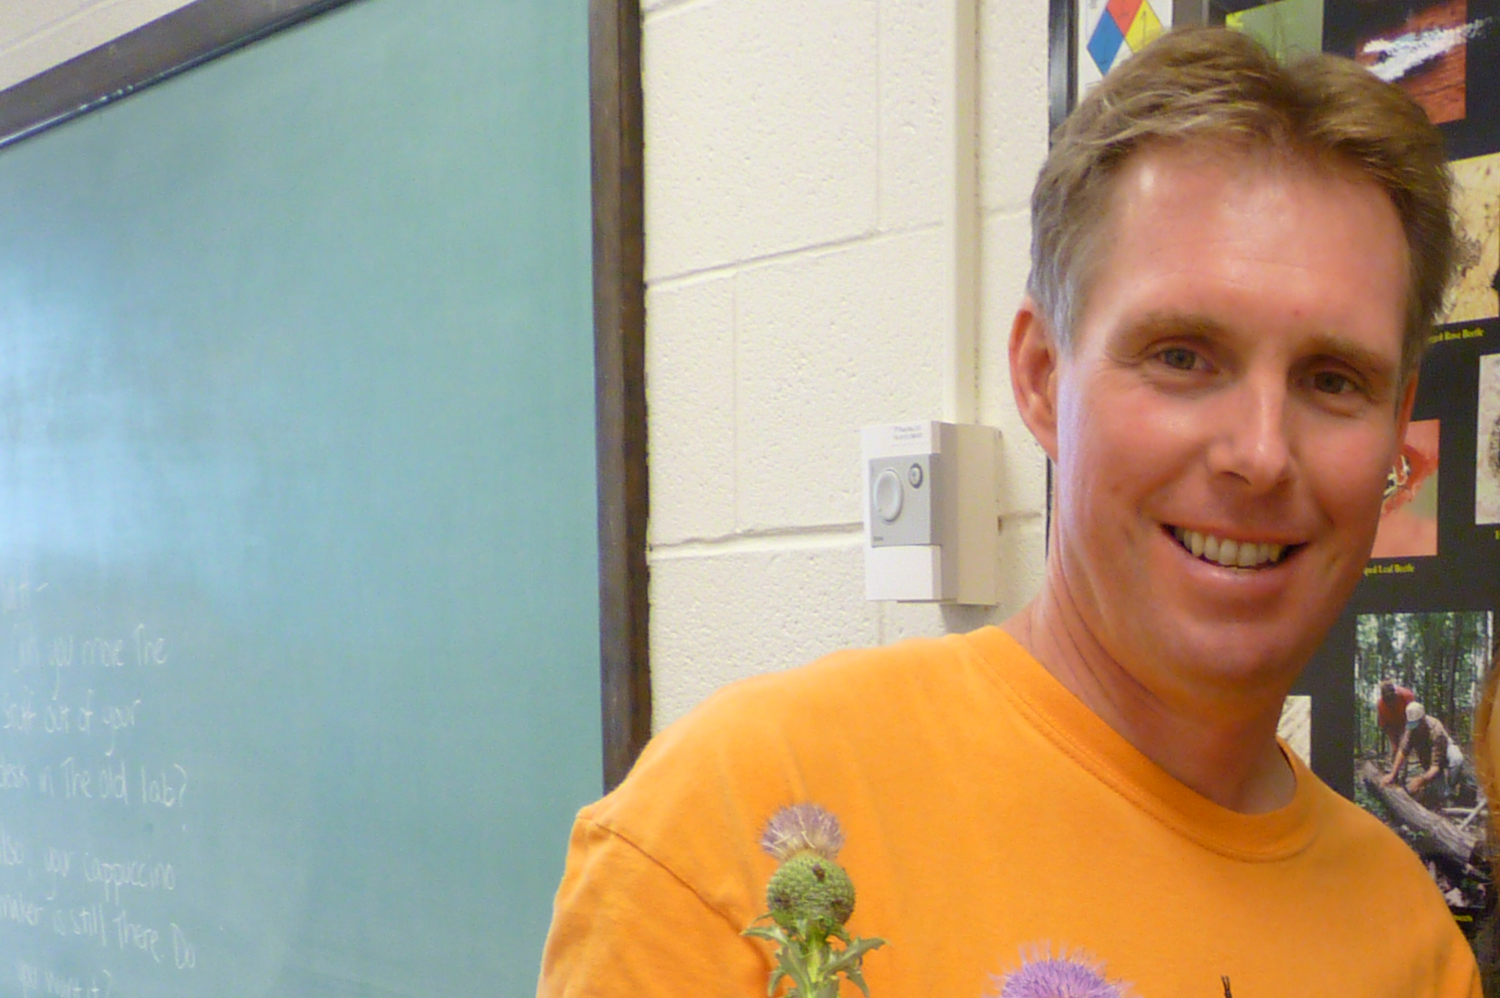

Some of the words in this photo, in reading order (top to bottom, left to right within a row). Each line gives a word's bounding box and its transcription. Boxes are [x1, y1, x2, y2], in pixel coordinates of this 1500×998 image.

[1462, 327, 1486, 339] Beetle
[1394, 562, 1416, 574] Beetle
[77, 688, 94, 737] of
[99, 759, 129, 806] old
[140, 763, 188, 808] lab?
[83, 852, 176, 907] cappuccino
[70, 902, 108, 948] still
[169, 922, 197, 970] Do
